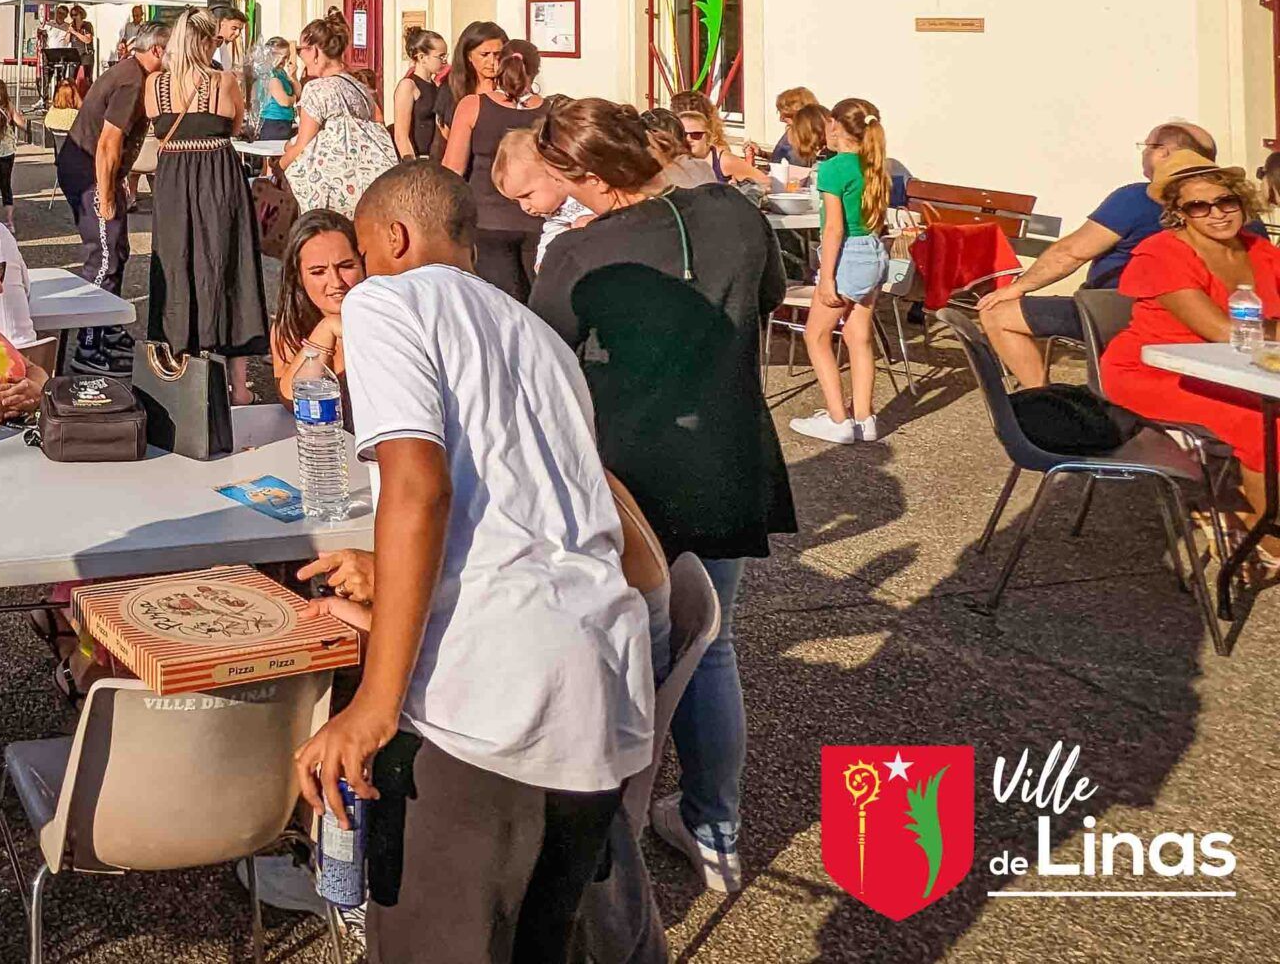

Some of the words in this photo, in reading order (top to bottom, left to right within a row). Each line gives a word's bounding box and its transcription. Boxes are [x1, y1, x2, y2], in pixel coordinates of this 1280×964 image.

[228, 664, 255, 676] Pizza
[269, 657, 295, 669] Pizza
[143, 697, 195, 711] VILLE
[201, 697, 223, 710] DE
